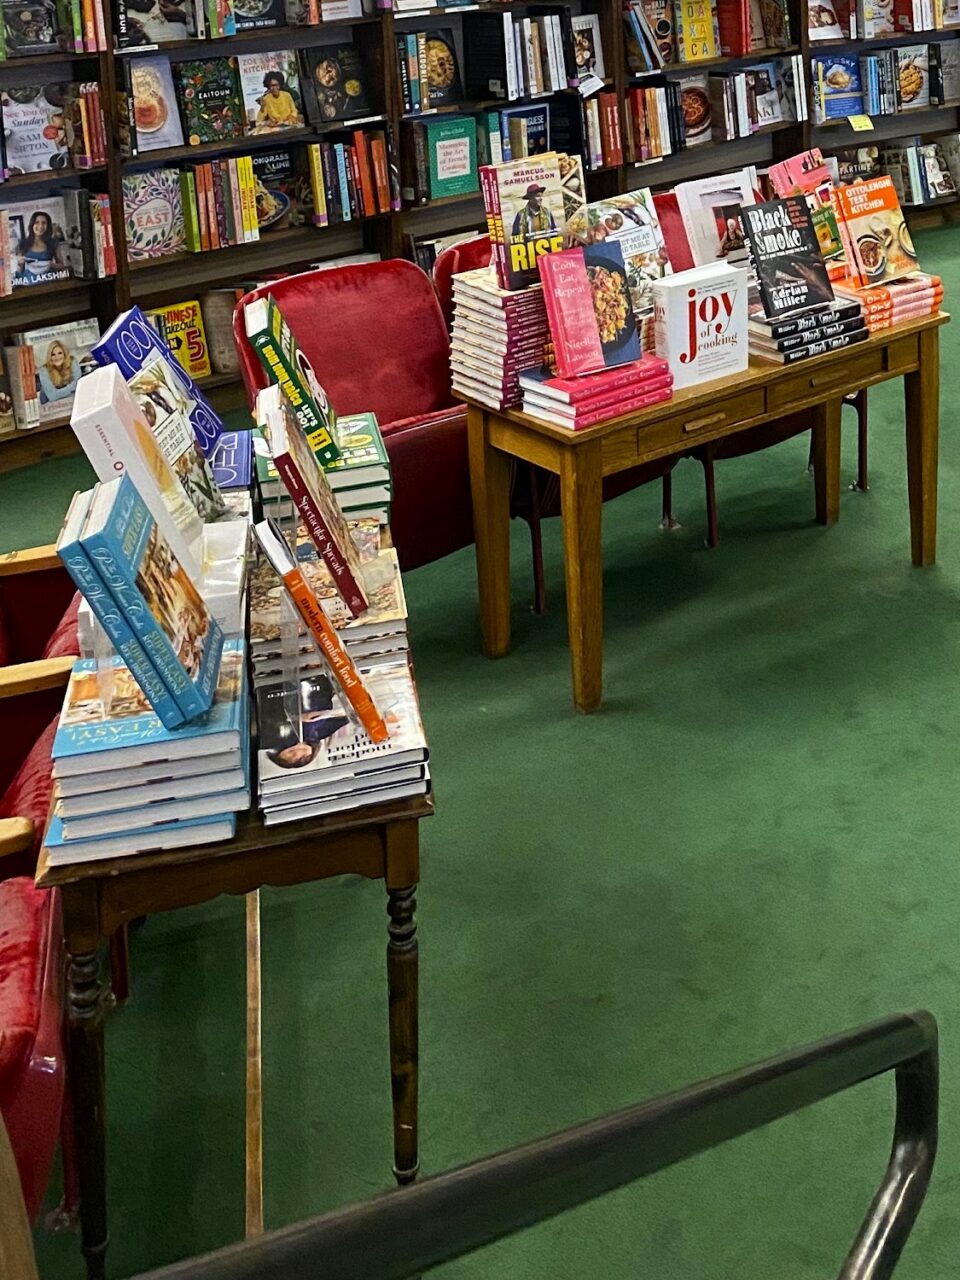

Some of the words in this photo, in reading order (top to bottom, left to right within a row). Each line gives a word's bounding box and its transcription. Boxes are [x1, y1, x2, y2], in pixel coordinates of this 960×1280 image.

[119, 13, 127, 33] SUN
[418, 38, 427, 84] MACEDONIA
[12, 118, 46, 128] Sunday
[19, 134, 42, 144] SAM
[504, 173, 555, 186] SAMUELSSON
[513, 167, 545, 177] MARCUS
[846, 178, 893, 198] OTTOLENGHI
[849, 194, 868, 207] TEST
[851, 199, 885, 215] KITCHEN
[136, 213, 170, 228] EAST
[748, 204, 792, 234] Black
[510, 233, 524, 244] THE
[631, 240, 650, 252] TABLE
[754, 229, 801, 255] Smoke
[510, 236, 563, 272] RISE
[552, 259, 578, 270] Cook,
[31, 269, 70, 284] LAKSHMI
[559, 274, 577, 285] Eat,
[554, 285, 585, 299] Repeat
[771, 284, 809, 301] Adrian
[773, 295, 807, 311] Miller
[798, 318, 817, 331] Black
[819, 311, 841, 323] Smoke
[679, 288, 738, 364] joy
[700, 324, 712, 338] of
[778, 325, 796, 334] Miller
[185, 327, 205, 361] 5
[565, 337, 595, 350] Nigella
[697, 333, 738, 352] cooking
[808, 342, 827, 355] Black
[566, 350, 599, 363] Lawson
[301, 404, 318, 428] LET'S
[95, 424, 115, 457] ESSENTIAL
[298, 495, 328, 542] Spectacular
[323, 541, 344, 577] Spreads
[300, 597, 324, 634] modern
[320, 631, 342, 670] comfort
[338, 663, 358, 688] food
[153, 654, 181, 696] DRUMMOND
[132, 663, 159, 704] DRUMMOND
